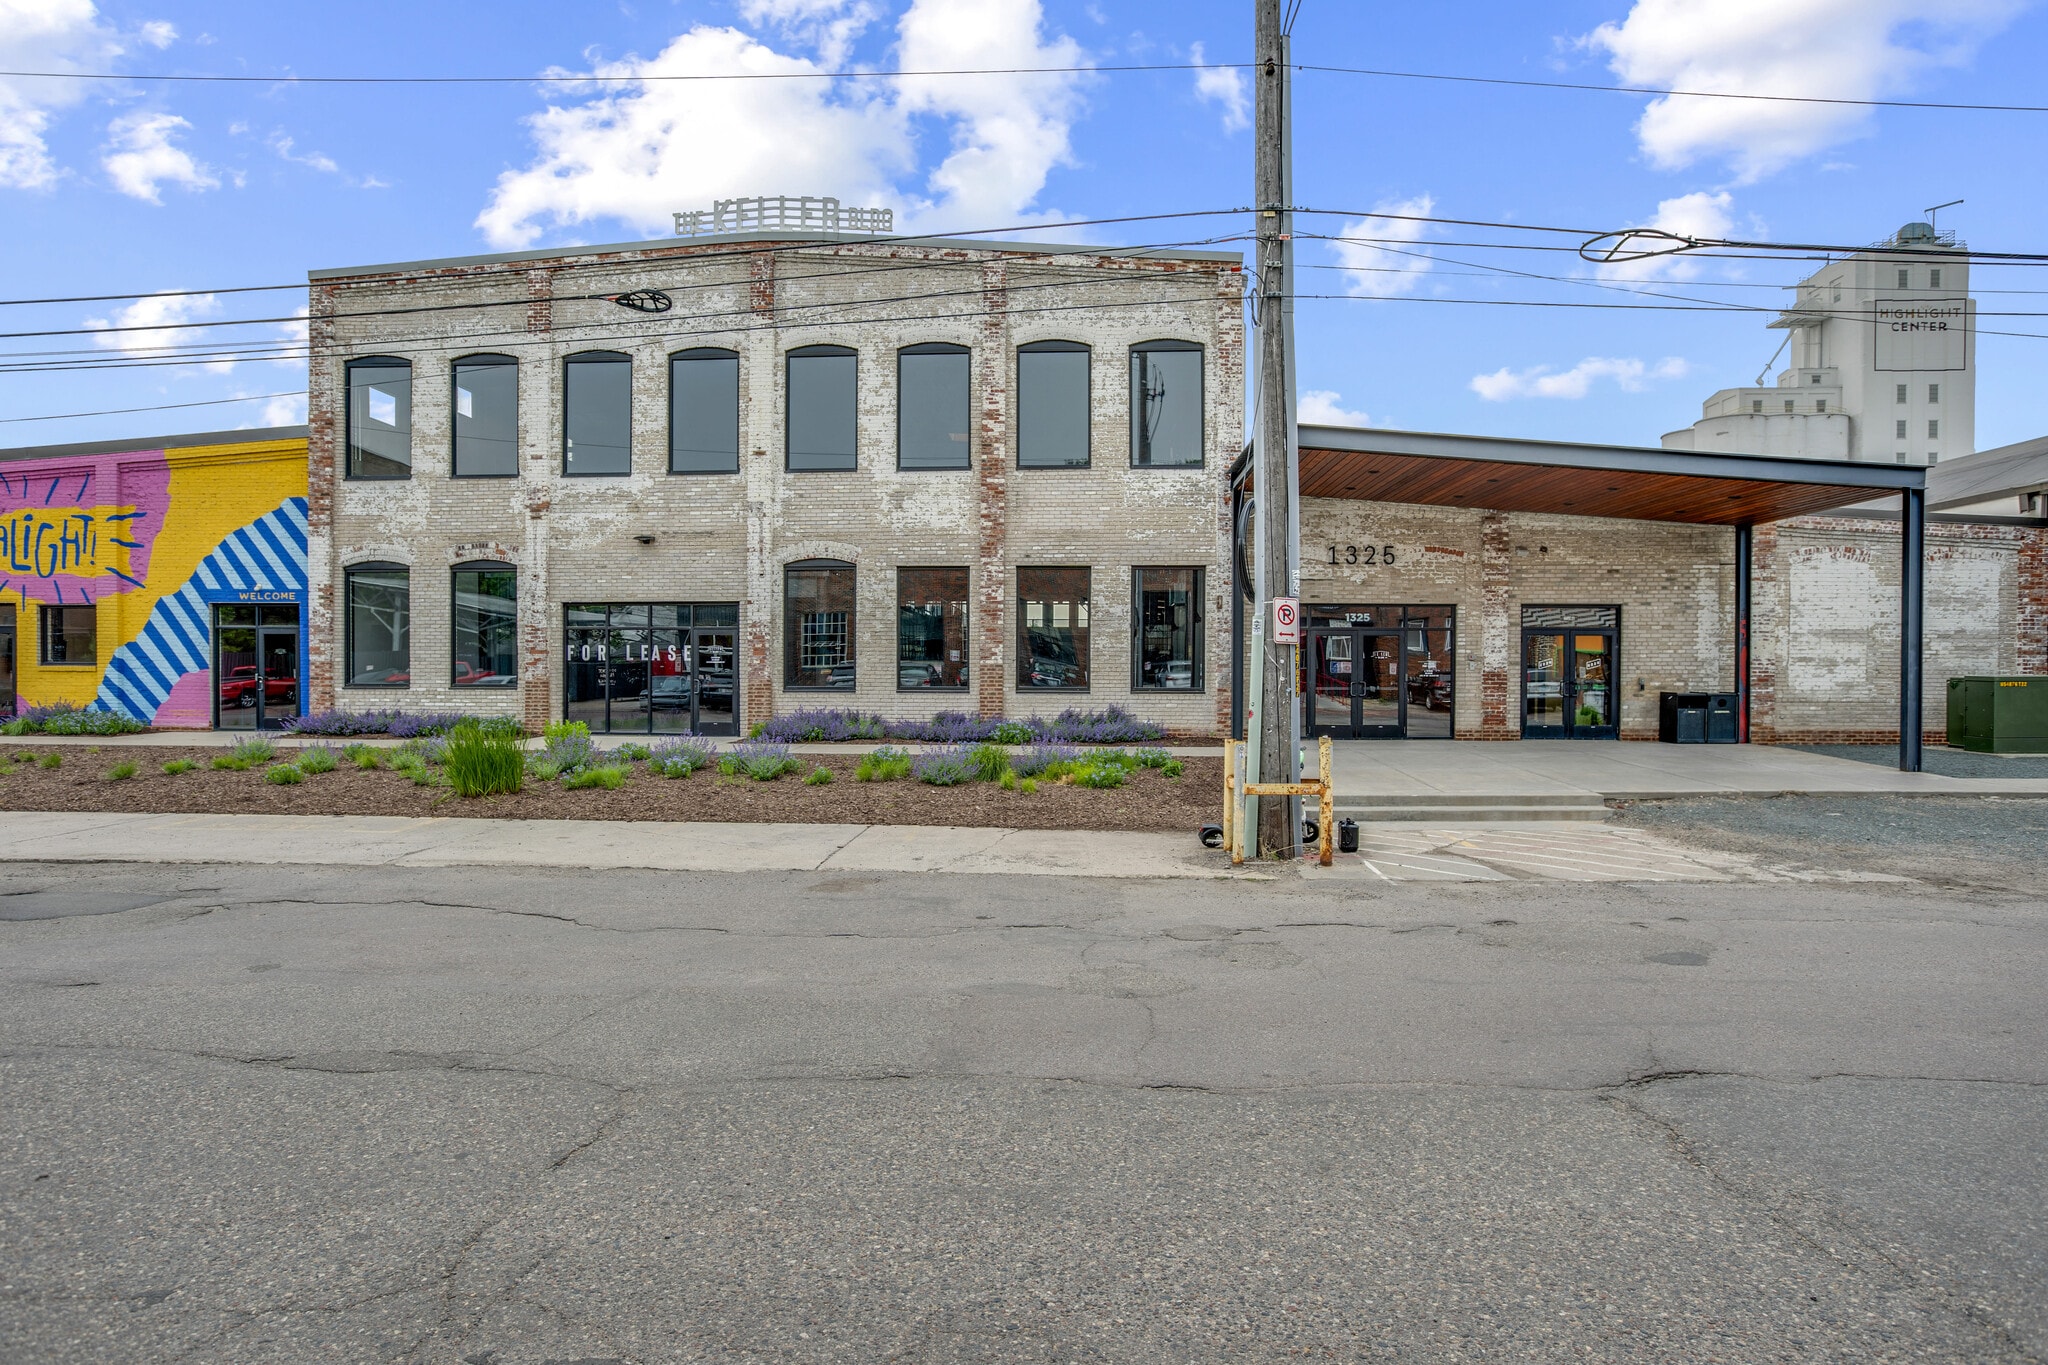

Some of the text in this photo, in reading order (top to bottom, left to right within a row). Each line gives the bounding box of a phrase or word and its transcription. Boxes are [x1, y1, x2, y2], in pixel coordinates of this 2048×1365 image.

[672, 195, 894, 236] THE KELLER BLDG
[1880, 308, 1961, 319] HIGHLIGHT
[1892, 321, 1949, 332] CENTER
[1328, 545, 1395, 565] 1325
[239, 592, 296, 601] WELCOME
[1344, 613, 1371, 622] 1325
[567, 645, 606, 661] FOR
[625, 645, 692, 661] LEASE
